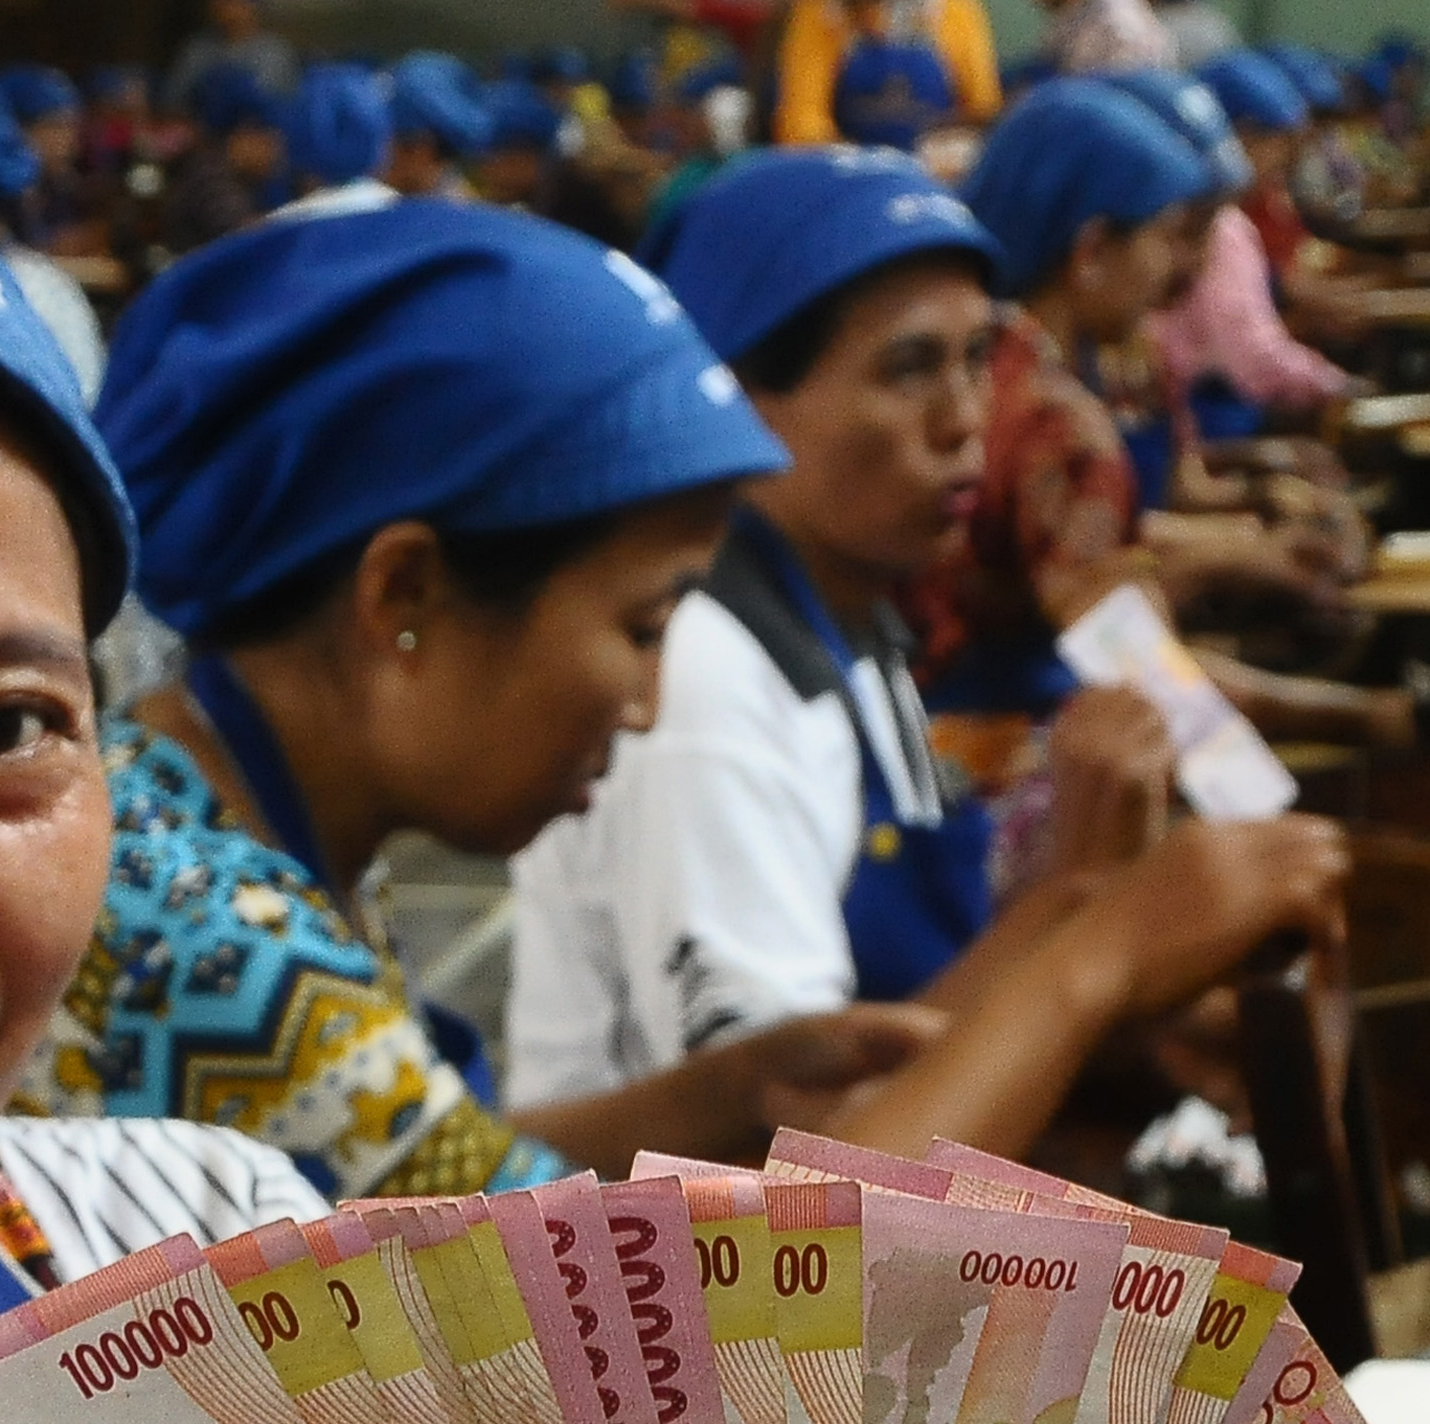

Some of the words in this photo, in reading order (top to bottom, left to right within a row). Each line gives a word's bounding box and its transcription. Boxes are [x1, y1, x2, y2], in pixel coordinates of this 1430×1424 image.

[959, 1250, 1078, 1292] 100000
[1111, 1260, 1186, 1318] 000
[59, 1297, 213, 1400] 100000
